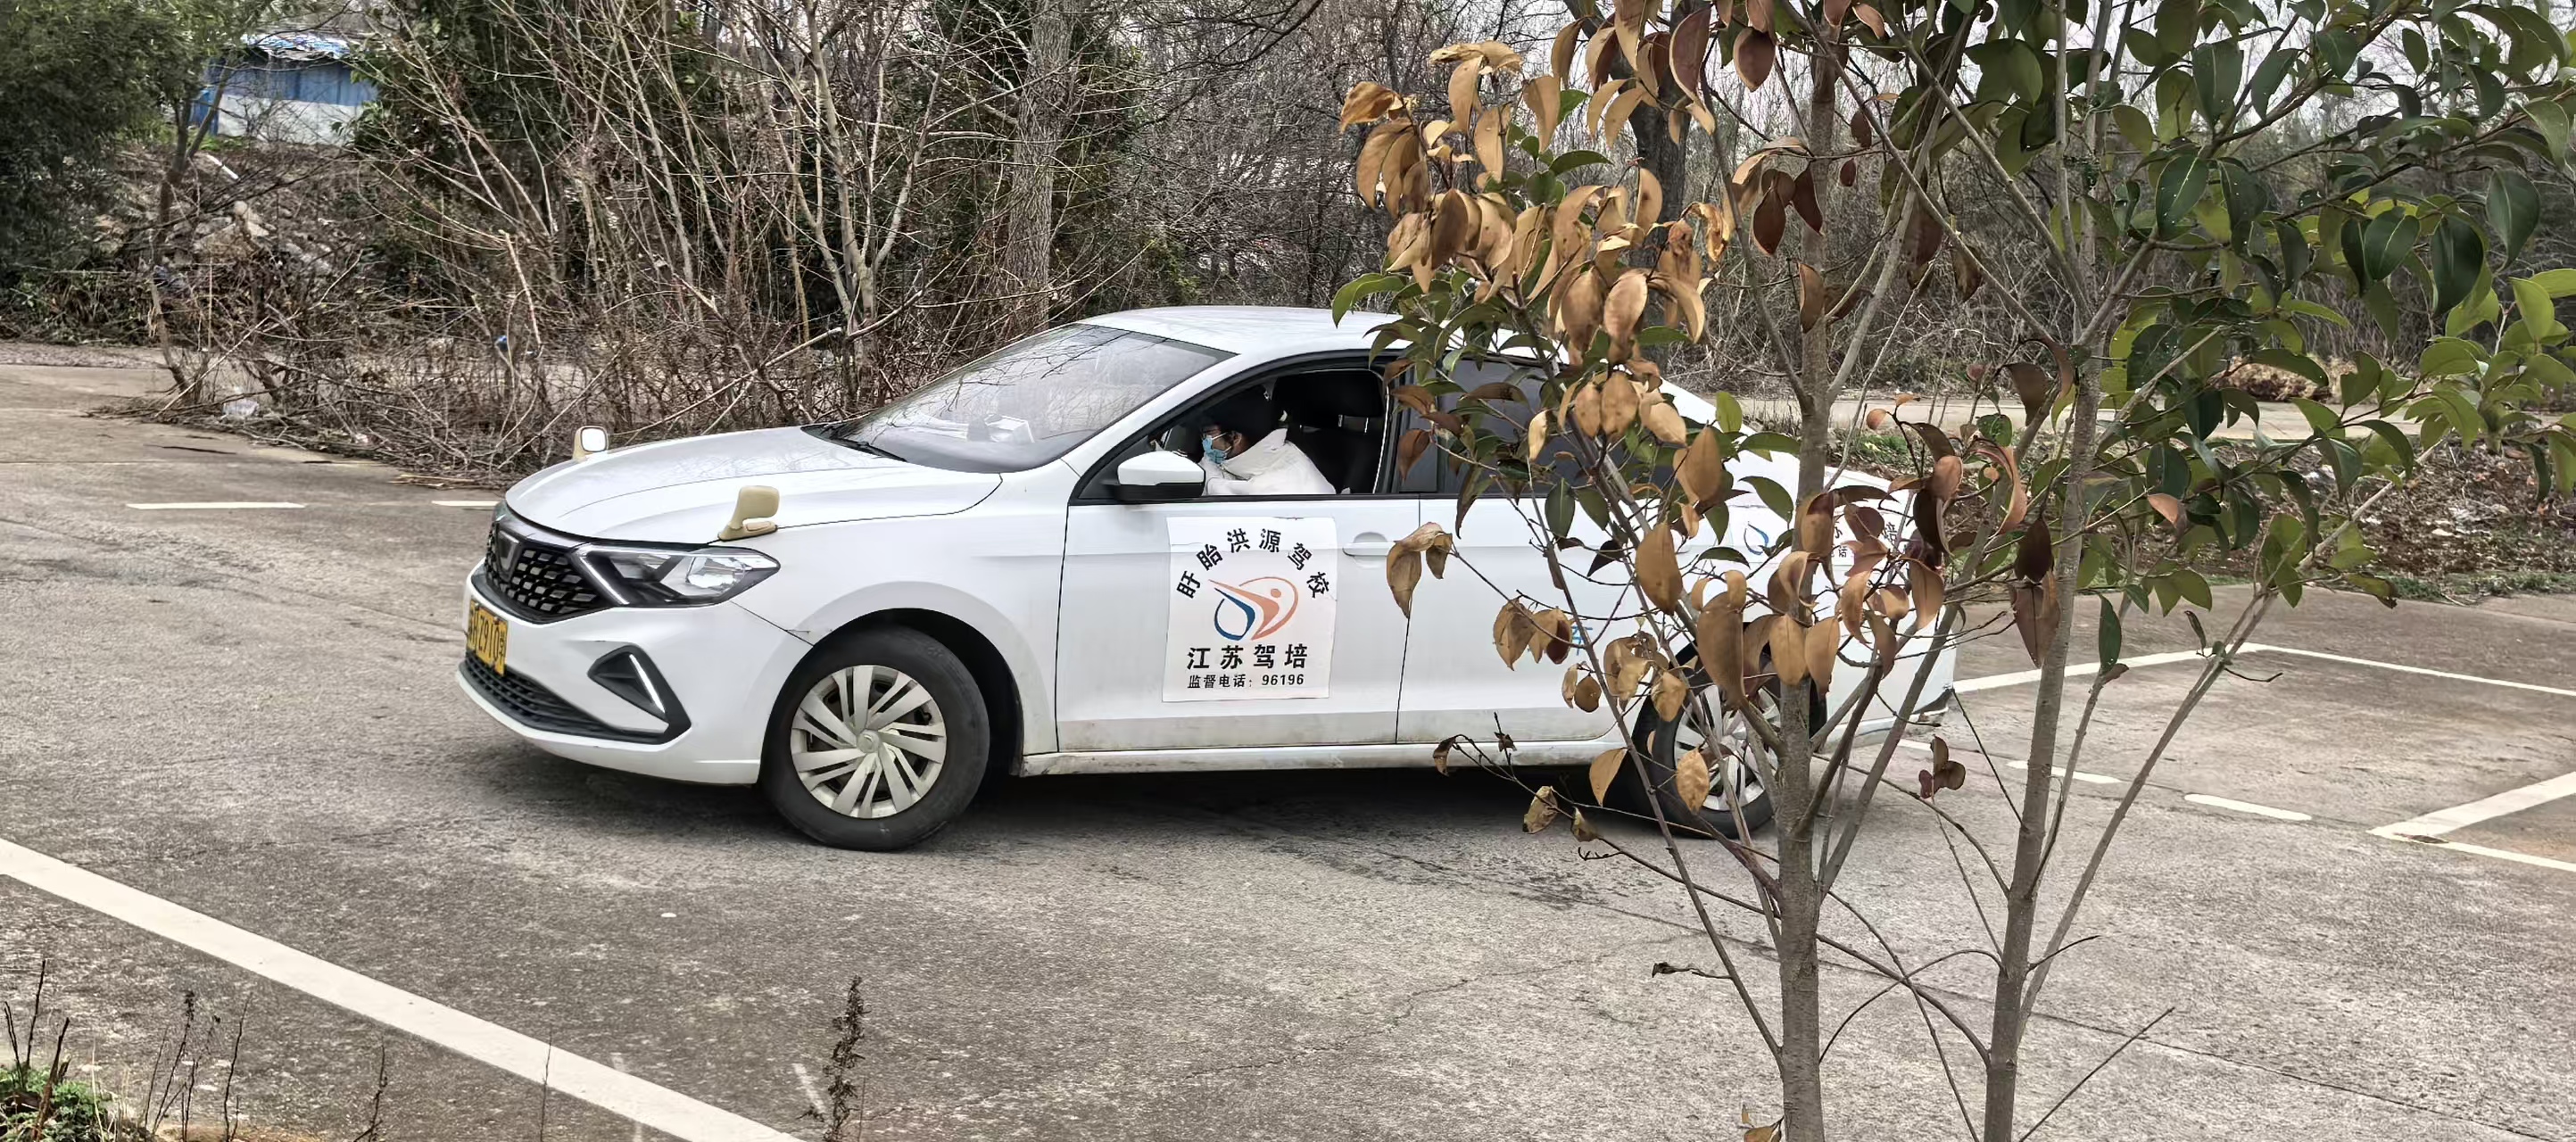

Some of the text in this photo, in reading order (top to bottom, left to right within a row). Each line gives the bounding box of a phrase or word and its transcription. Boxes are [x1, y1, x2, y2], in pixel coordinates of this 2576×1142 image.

[1176, 528, 1329, 599] 盱眙洪源驾校
[1187, 643, 1308, 670] 江苏驾培
[1262, 674, 1305, 685] 96196
